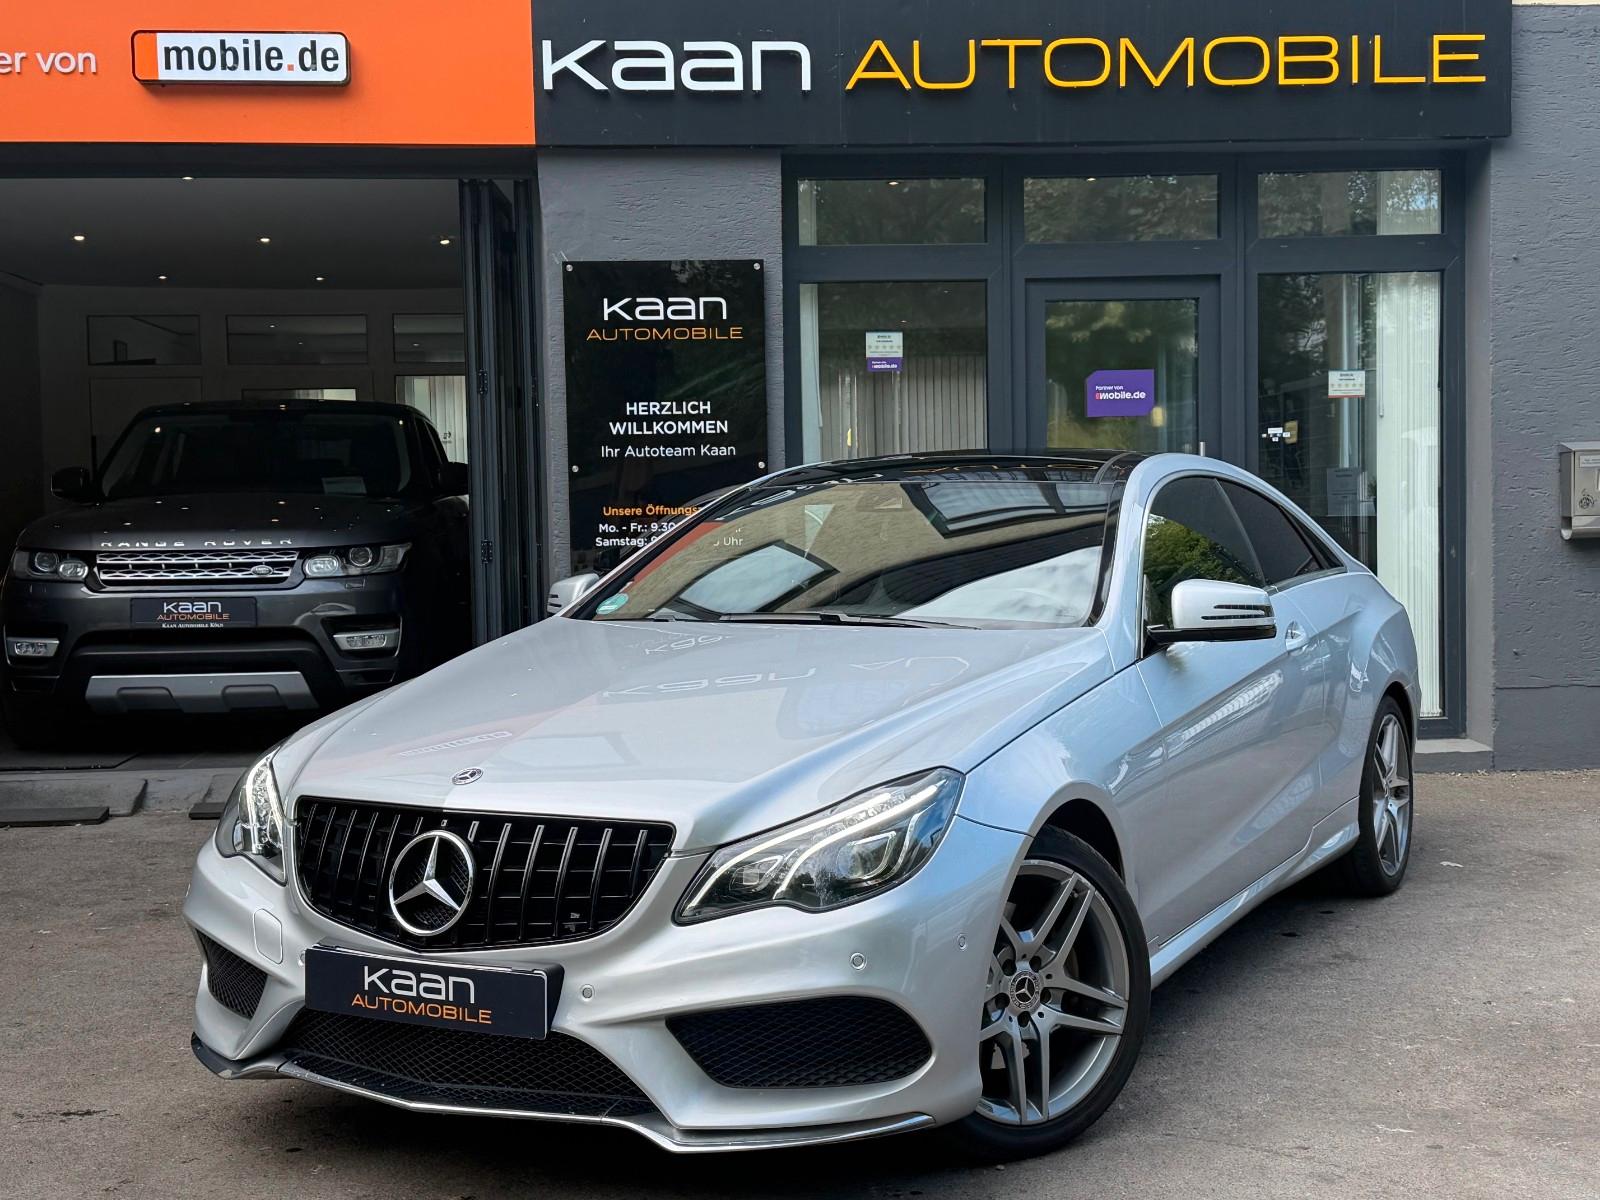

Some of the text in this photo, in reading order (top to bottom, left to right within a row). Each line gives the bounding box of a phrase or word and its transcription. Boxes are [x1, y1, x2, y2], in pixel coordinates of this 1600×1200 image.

[163, 38, 339, 72] mobile.de
[35, 52, 97, 73] von
[845, 34, 1486, 91] AUTOMOBILE
[586, 326, 744, 341] AUTOMOBILE
[626, 401, 711, 415] HERZLICH
[609, 420, 728, 435] WILLKOMMEN
[601, 444, 736, 458] Ihr Autoteam Kaan
[603, 504, 701, 516] Unsere Öffnungs
[598, 523, 619, 533] Mo.
[630, 522, 647, 533] Fr.:
[595, 536, 648, 548] Samstag:
[723, 536, 744, 546] Uhr
[156, 613, 230, 621] AUTOMOBILE
[352, 993, 492, 1025] AUTOMOBILE
